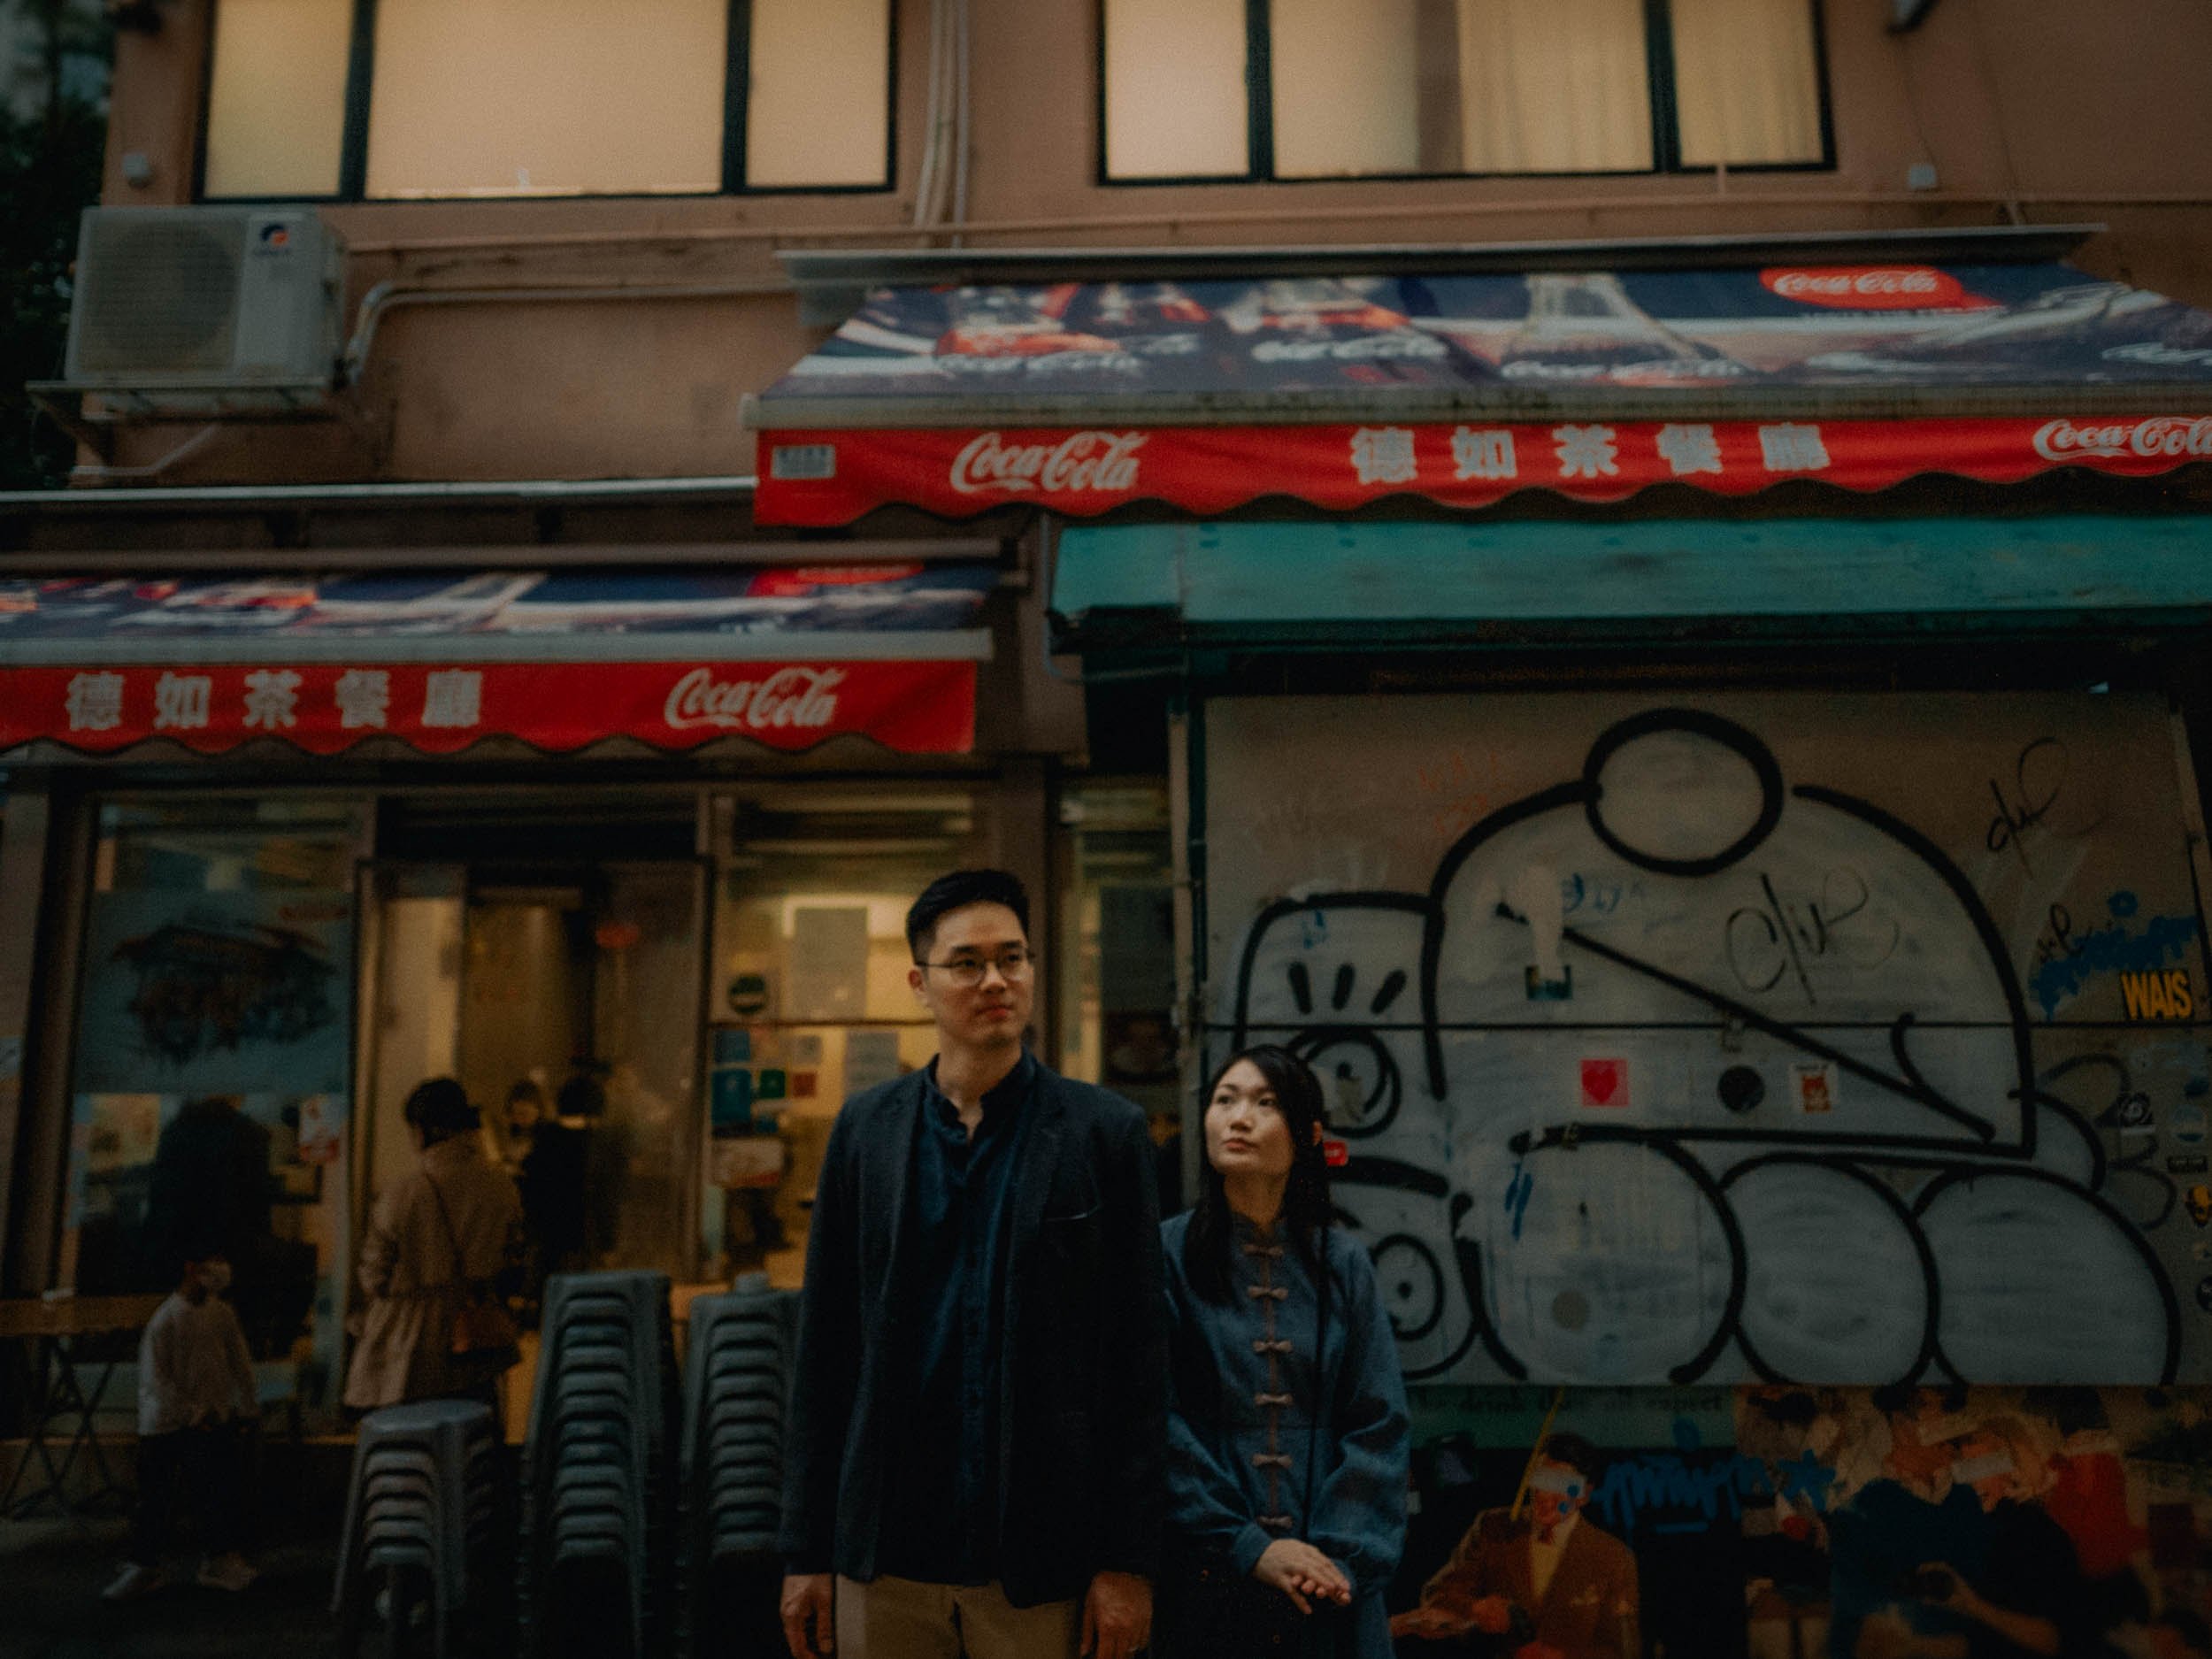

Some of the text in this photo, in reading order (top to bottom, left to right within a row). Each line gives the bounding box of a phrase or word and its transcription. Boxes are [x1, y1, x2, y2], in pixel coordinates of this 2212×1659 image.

[949, 431, 1149, 494] Coca-Cola
[664, 666, 848, 730] Coca-Cola
[2120, 969, 2193, 1020] WAIS
